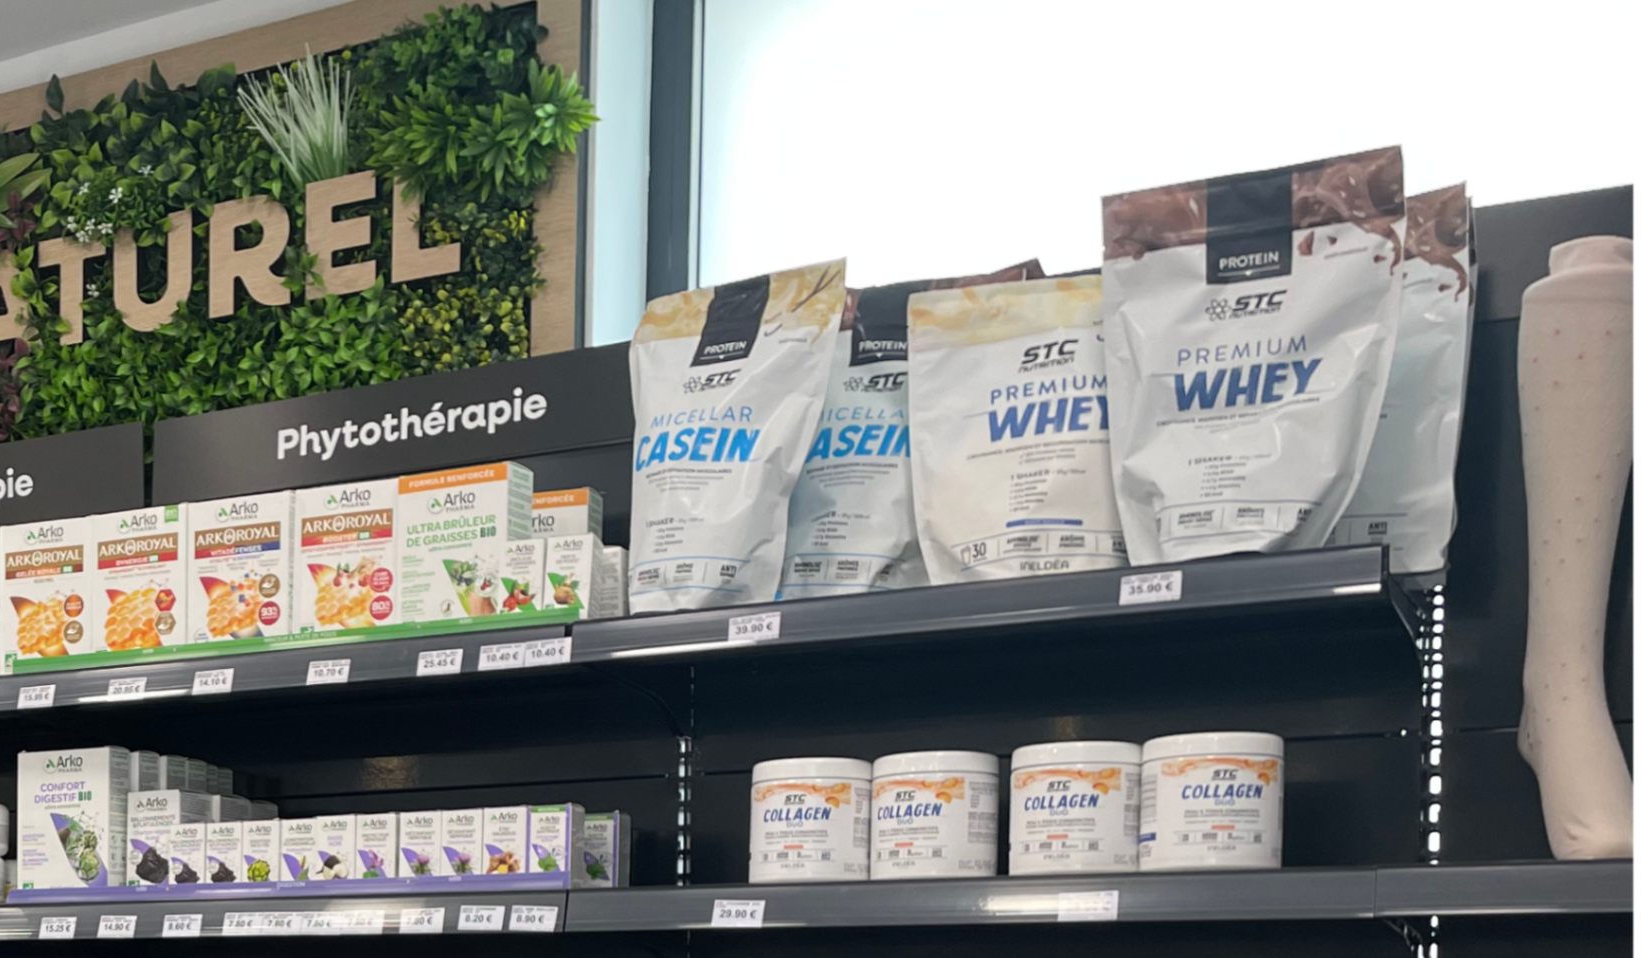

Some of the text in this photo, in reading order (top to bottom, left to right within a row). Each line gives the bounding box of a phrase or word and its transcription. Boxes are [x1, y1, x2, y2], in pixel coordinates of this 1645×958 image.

[1218, 250, 1279, 270] PROTEIN
[1232, 290, 1287, 312] STC
[704, 341, 747, 354] PROTEIN
[858, 341, 908, 352] PROTEIN
[1022, 339, 1079, 365] STC
[1176, 334, 1308, 366] PREMIUM
[990, 376, 1108, 405] PREMIUM
[1173, 358, 1323, 412] WHEY
[276, 388, 548, 461] Phytothérapie
[651, 406, 752, 428] MICELLAR
[988, 396, 1110, 442] WHEY
[635, 427, 760, 473] CASEIN
[408, 469, 495, 489] FORMULE RENFORCÉE
[444, 491, 476, 505] Arko
[130, 514, 158, 527] Arko
[407, 514, 497, 535] ULTRA BRÛLEUR
[406, 526, 497, 548] DE GRAISSES BIO
[972, 542, 987, 558] 30
[1127, 581, 1174, 595] 35.90 €
[486, 652, 518, 662] 10.40 €
[40, 782, 85, 792] CONFORT
[1181, 782, 1263, 801] COLLAGEN
[34, 791, 92, 804] DIGESTIF BIO
[1023, 793, 1099, 812] COLLAGEN
[763, 805, 832, 823] COLLAGEN
[719, 907, 757, 920] 29.90 €
